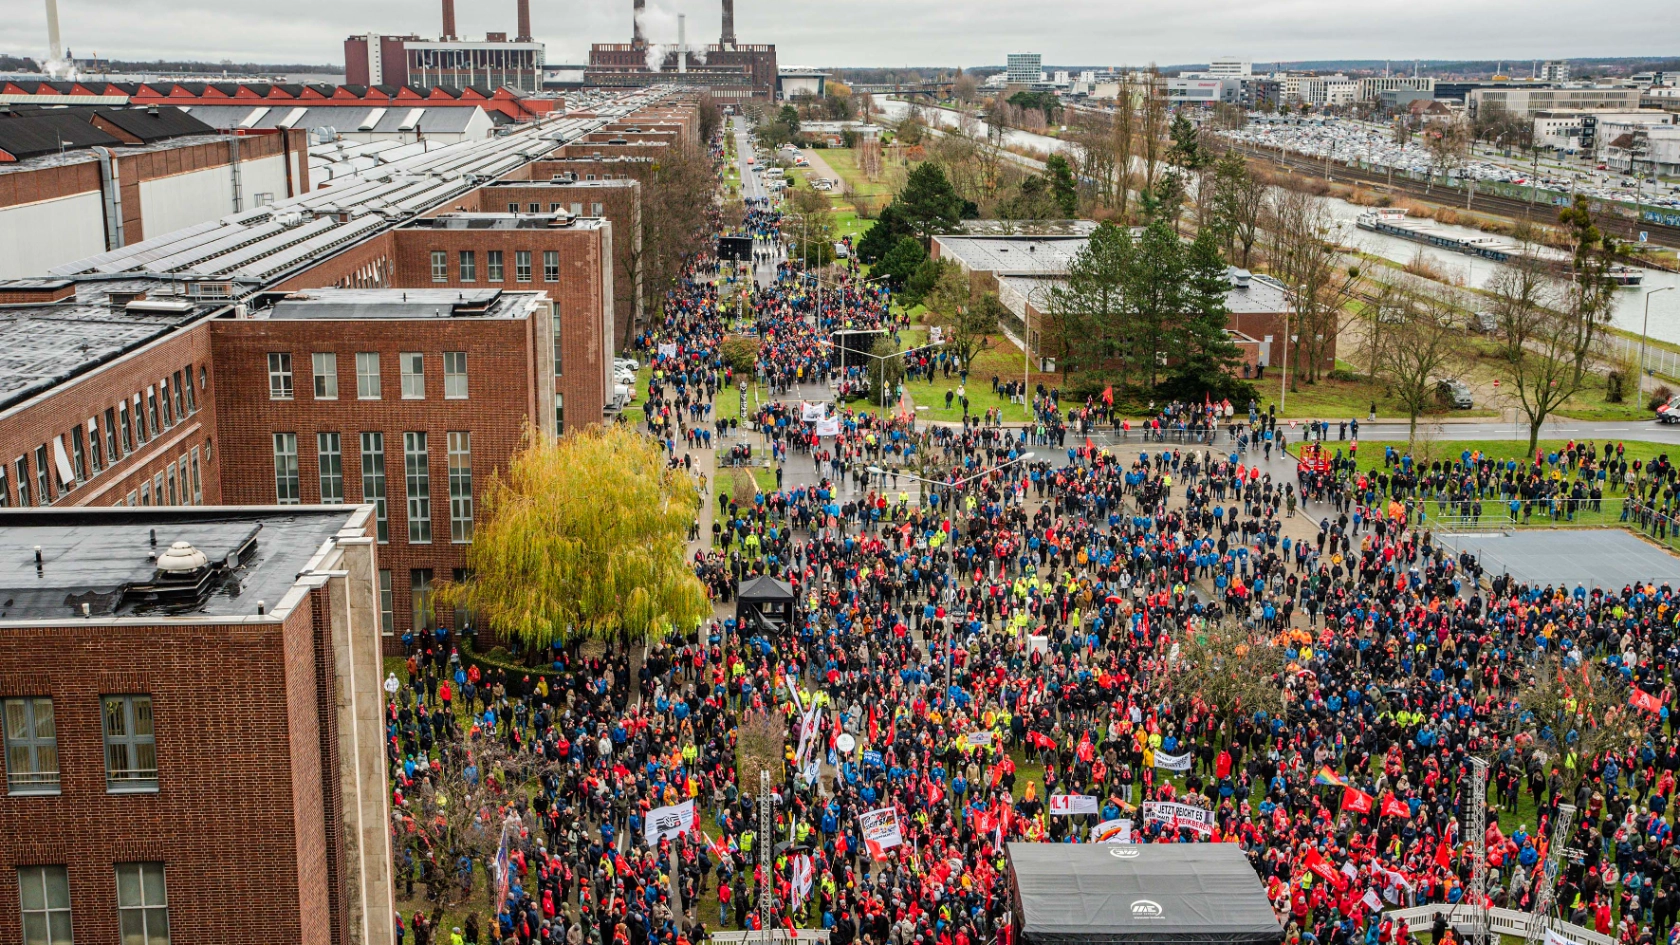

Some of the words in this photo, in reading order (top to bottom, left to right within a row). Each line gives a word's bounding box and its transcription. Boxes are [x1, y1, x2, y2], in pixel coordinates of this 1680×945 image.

[1062, 795, 1069, 809] 1
[1158, 805, 1175, 815] JETZT
[1176, 807, 1195, 818] REICHT
[1195, 811, 1203, 821] ES
